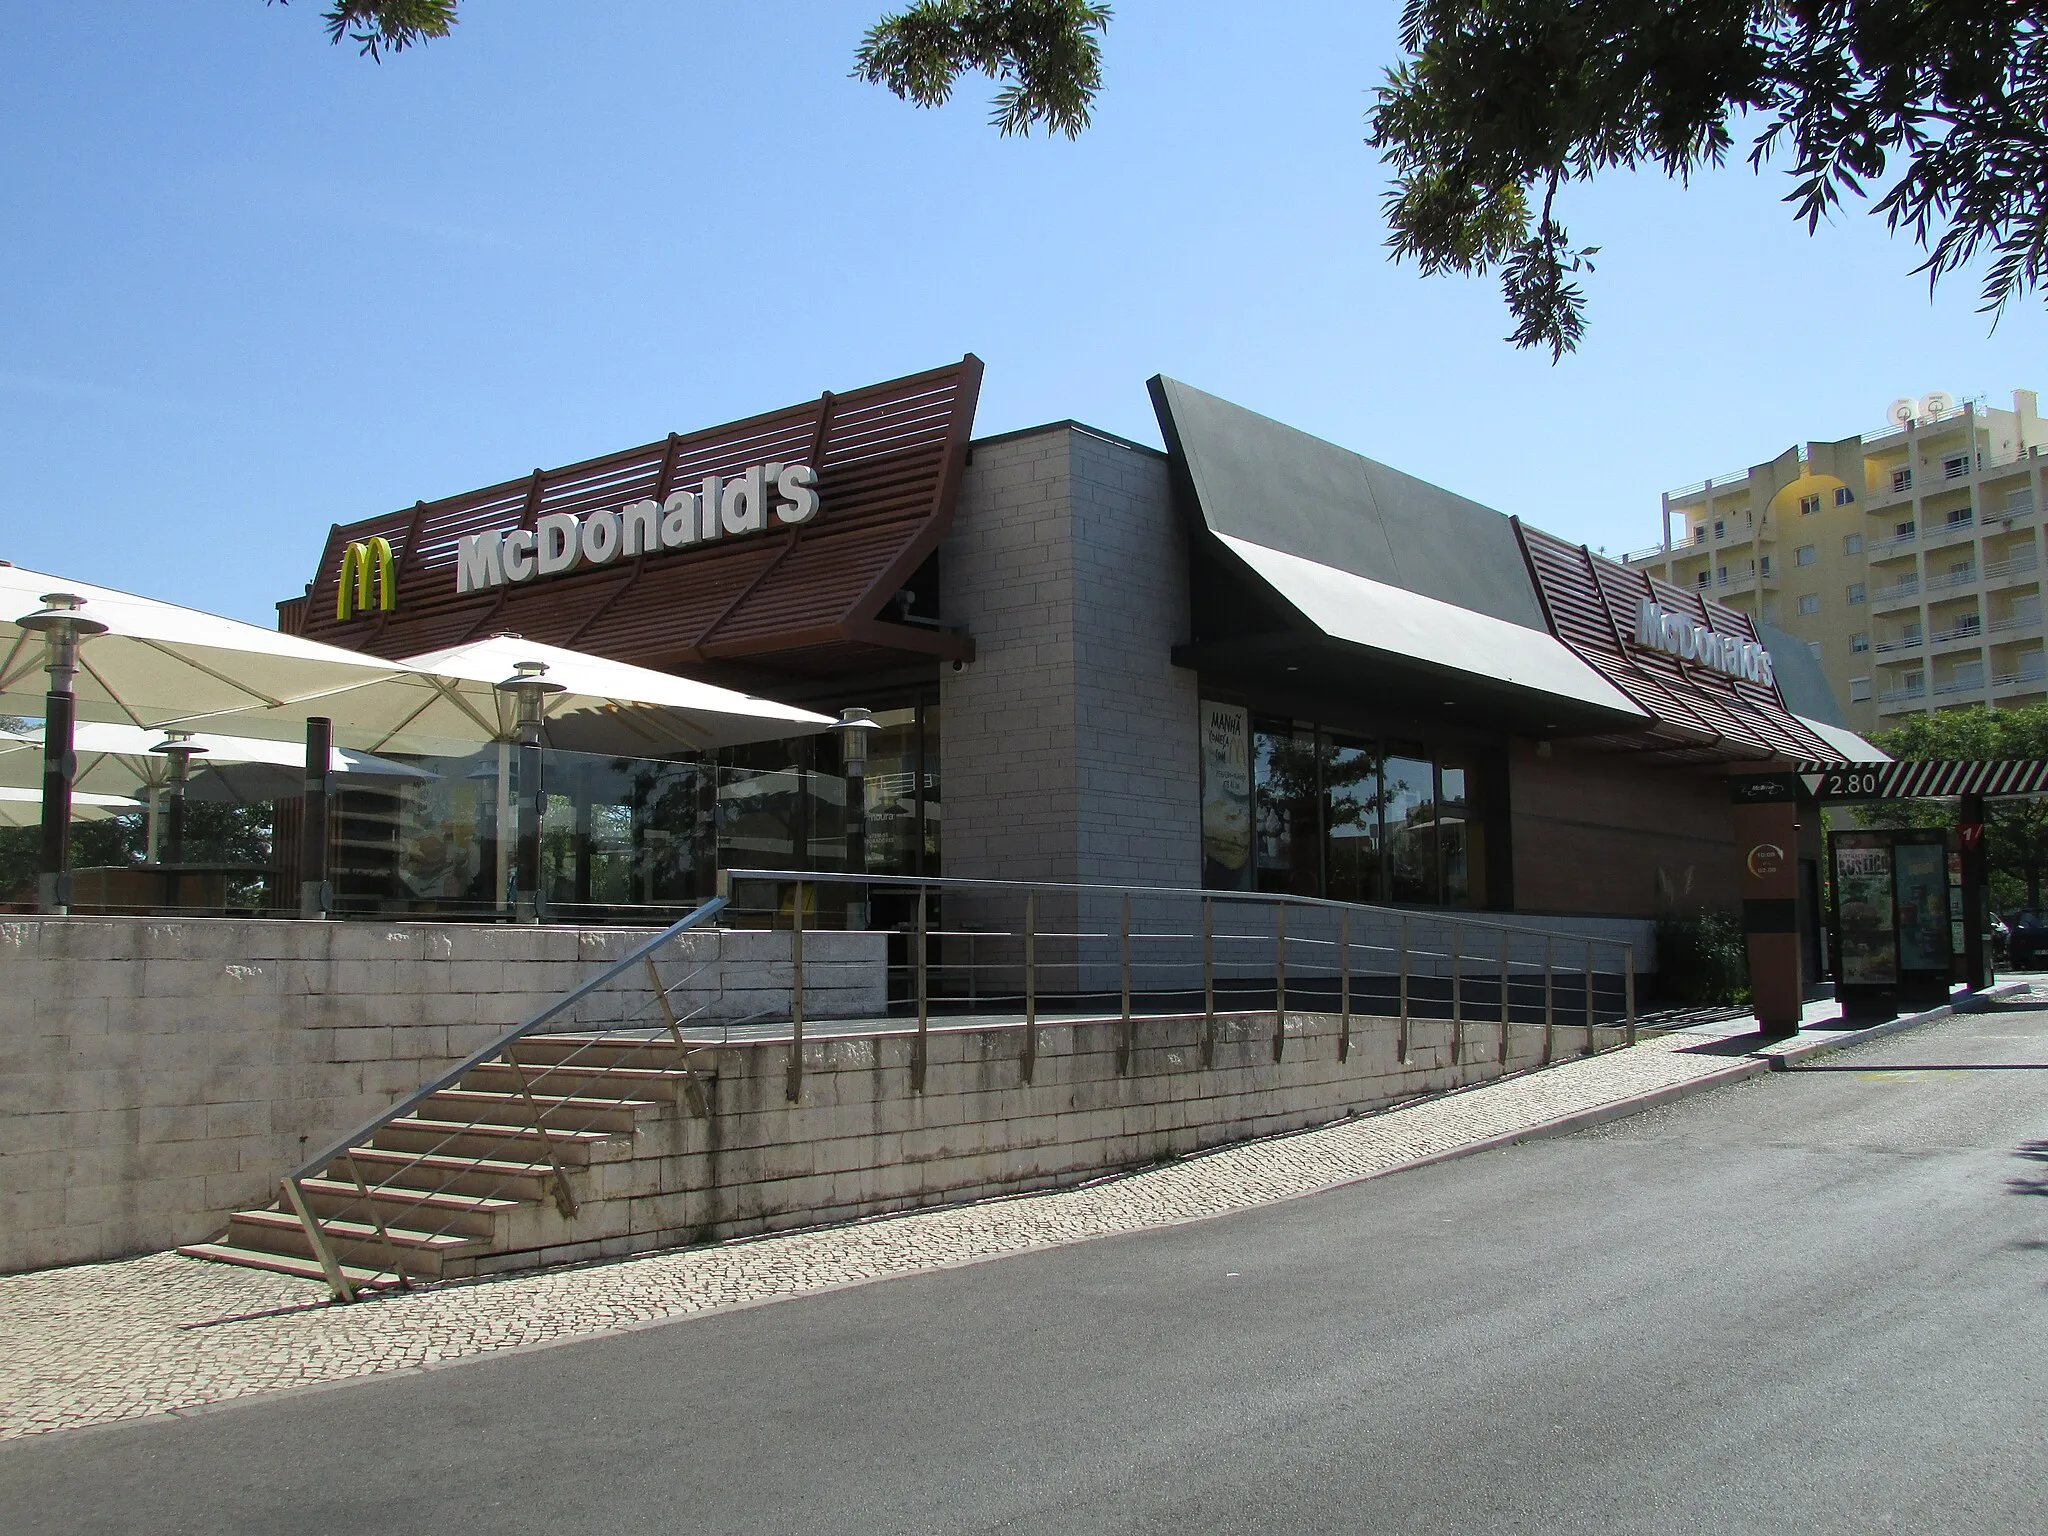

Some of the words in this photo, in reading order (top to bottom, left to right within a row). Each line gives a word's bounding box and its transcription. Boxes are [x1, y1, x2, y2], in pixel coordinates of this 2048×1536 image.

[456, 462, 820, 593] McDonald's
[1634, 598, 1773, 688] McDonald's
[1210, 711, 1242, 736] MANHÃ
[1830, 774, 1875, 794] 2.80
